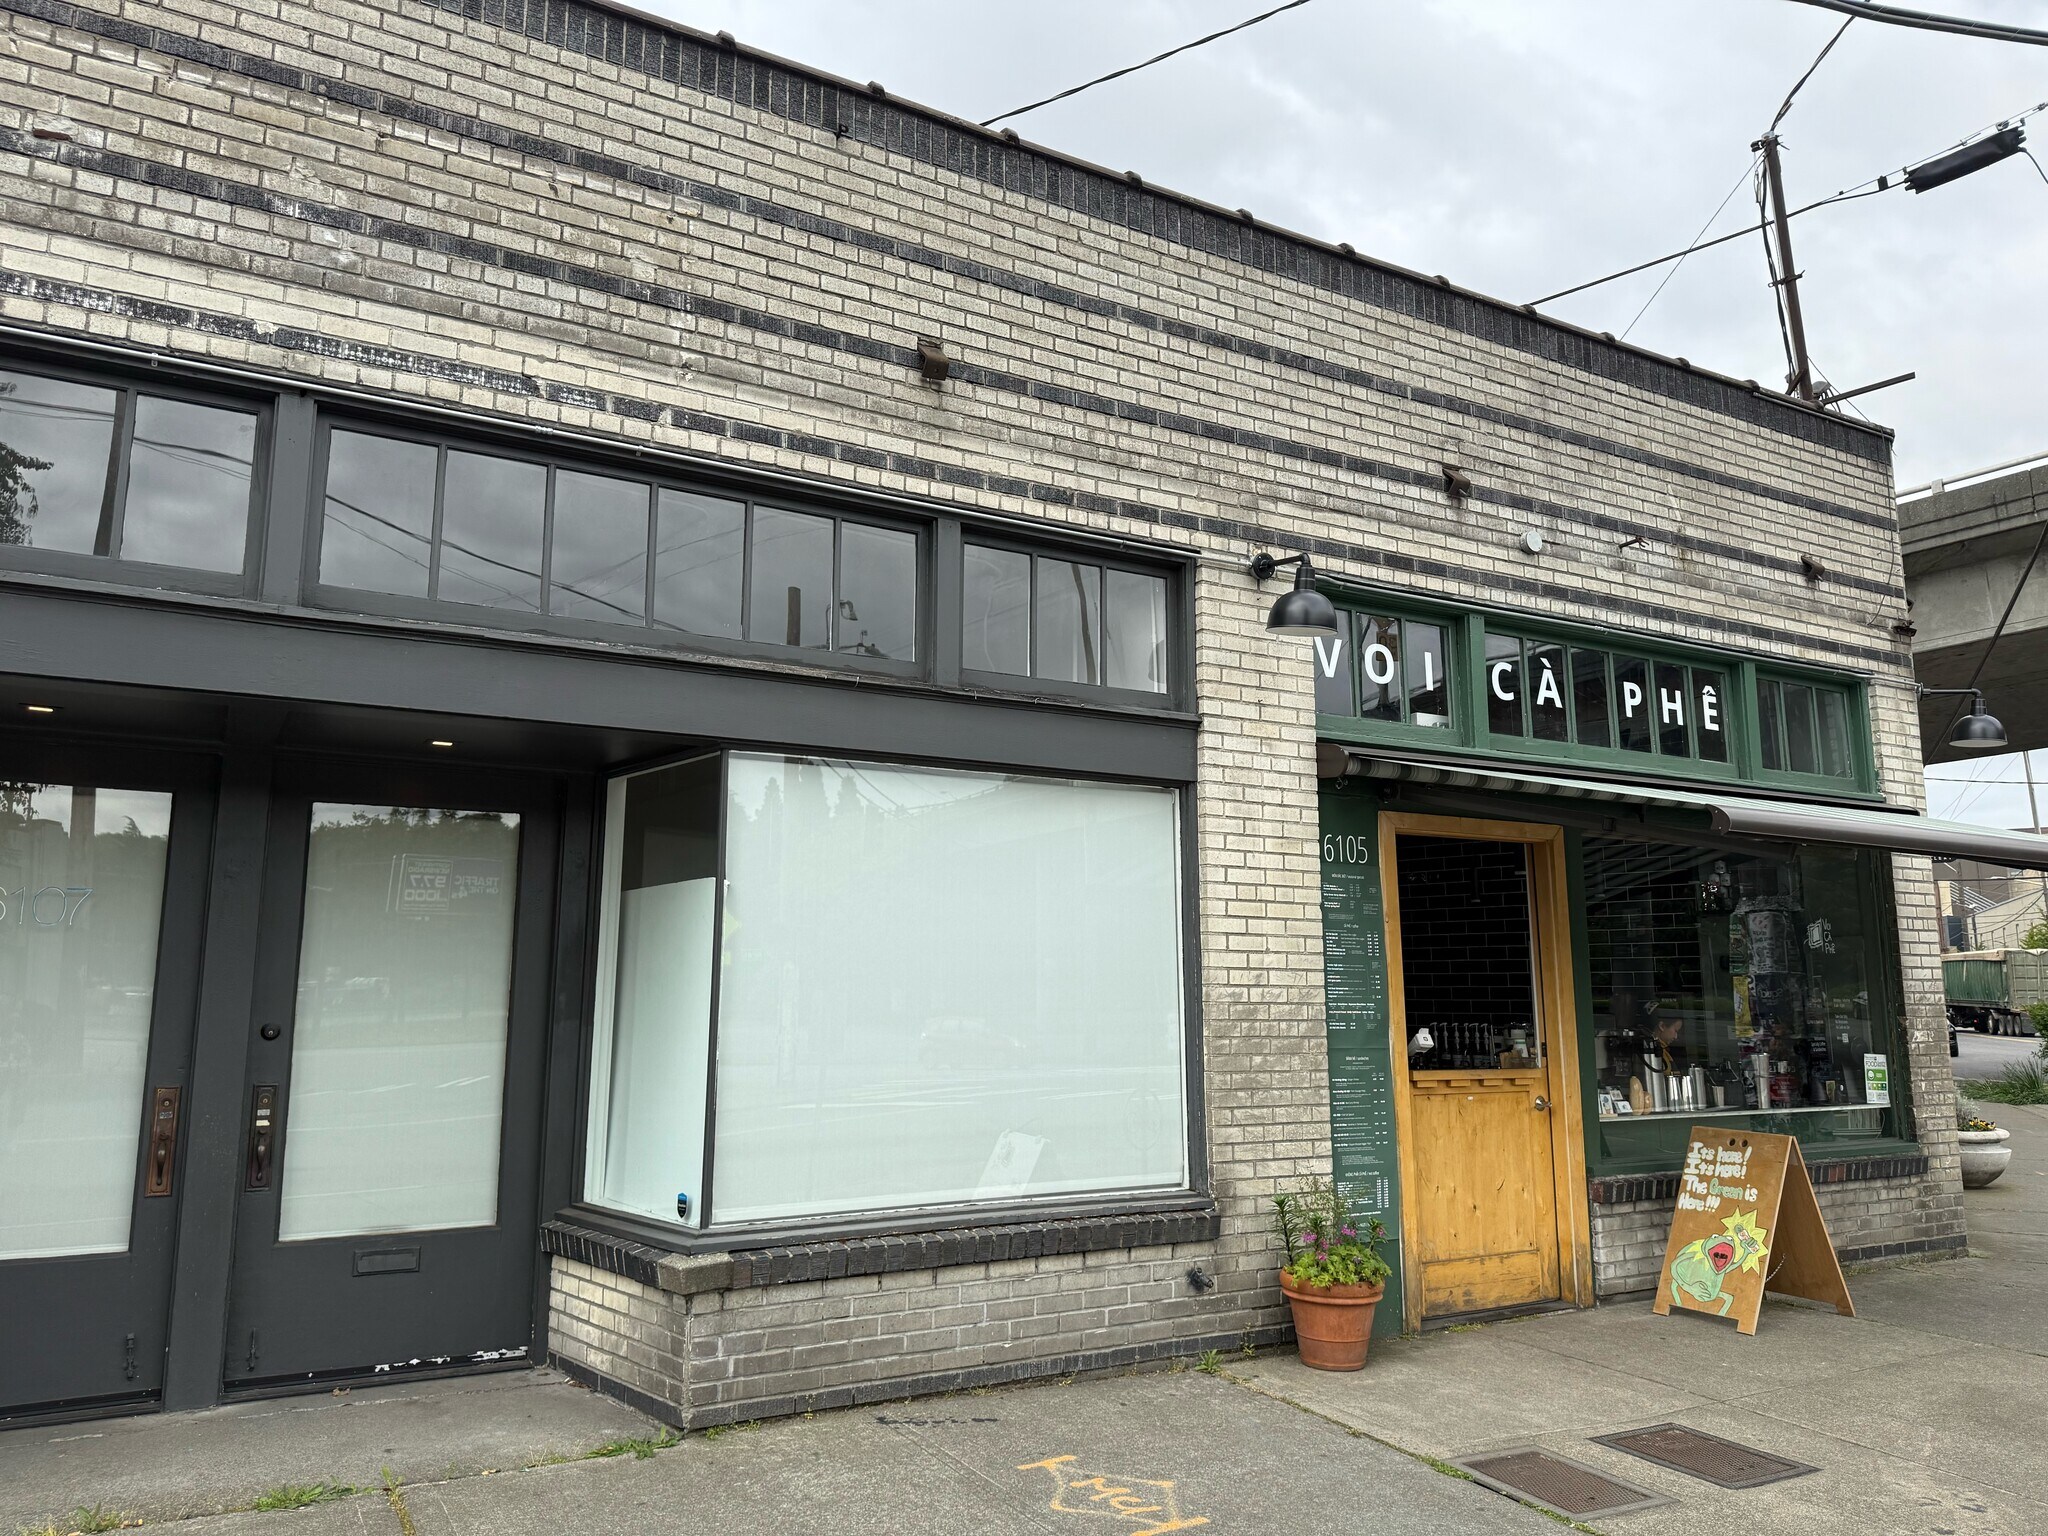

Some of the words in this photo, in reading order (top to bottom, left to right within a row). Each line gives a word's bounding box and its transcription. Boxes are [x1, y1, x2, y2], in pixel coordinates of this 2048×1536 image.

[1314, 636, 1434, 692] VOI
[1491, 657, 1563, 709] CÀ
[1623, 681, 1720, 732] PHÊ
[1324, 834, 1368, 864] 6105
[0, 887, 94, 926] 107
[1683, 1174, 1708, 1195] The
[1709, 1177, 1744, 1201] Green
[1744, 1183, 1758, 1203] is
